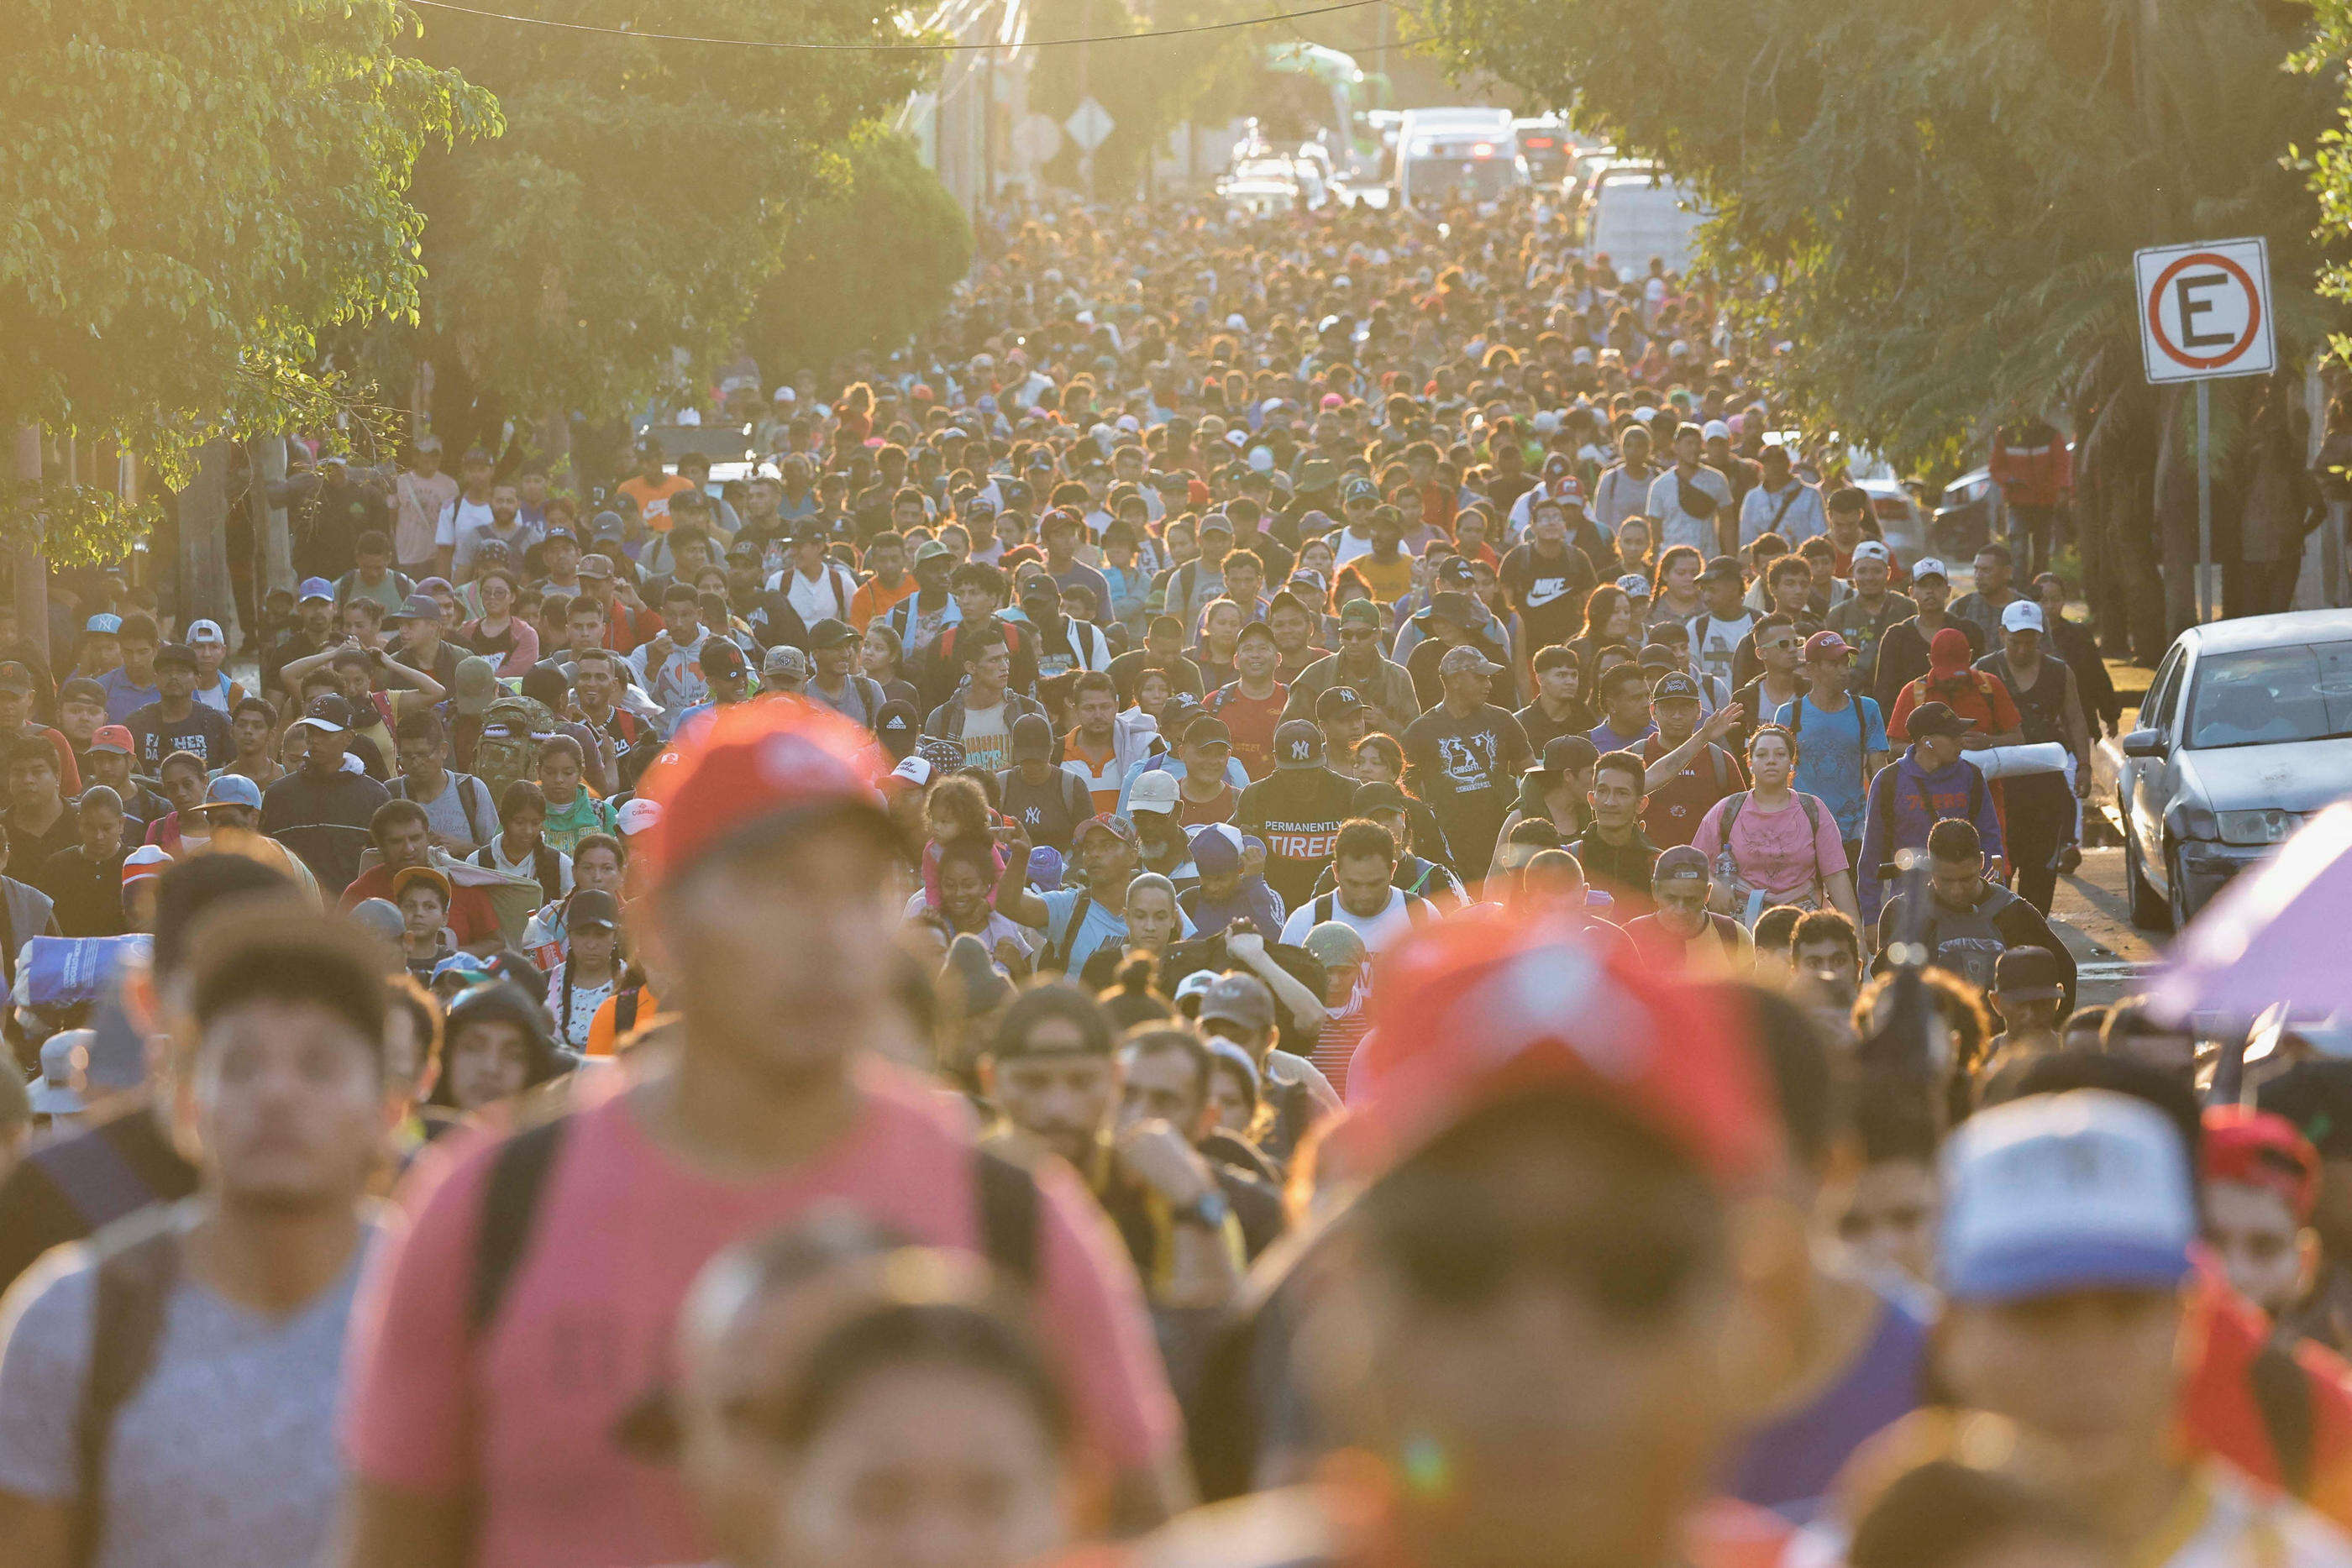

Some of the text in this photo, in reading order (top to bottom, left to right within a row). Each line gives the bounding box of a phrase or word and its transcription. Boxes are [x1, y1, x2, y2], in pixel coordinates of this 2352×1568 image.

[2176, 273, 2234, 348] E
[1532, 578, 1566, 595] NIKE
[145, 733, 207, 750] FHER
[1292, 740, 1310, 760] NY
[1025, 806, 1042, 825] NY
[1265, 821, 1342, 832] PERMANENTLY
